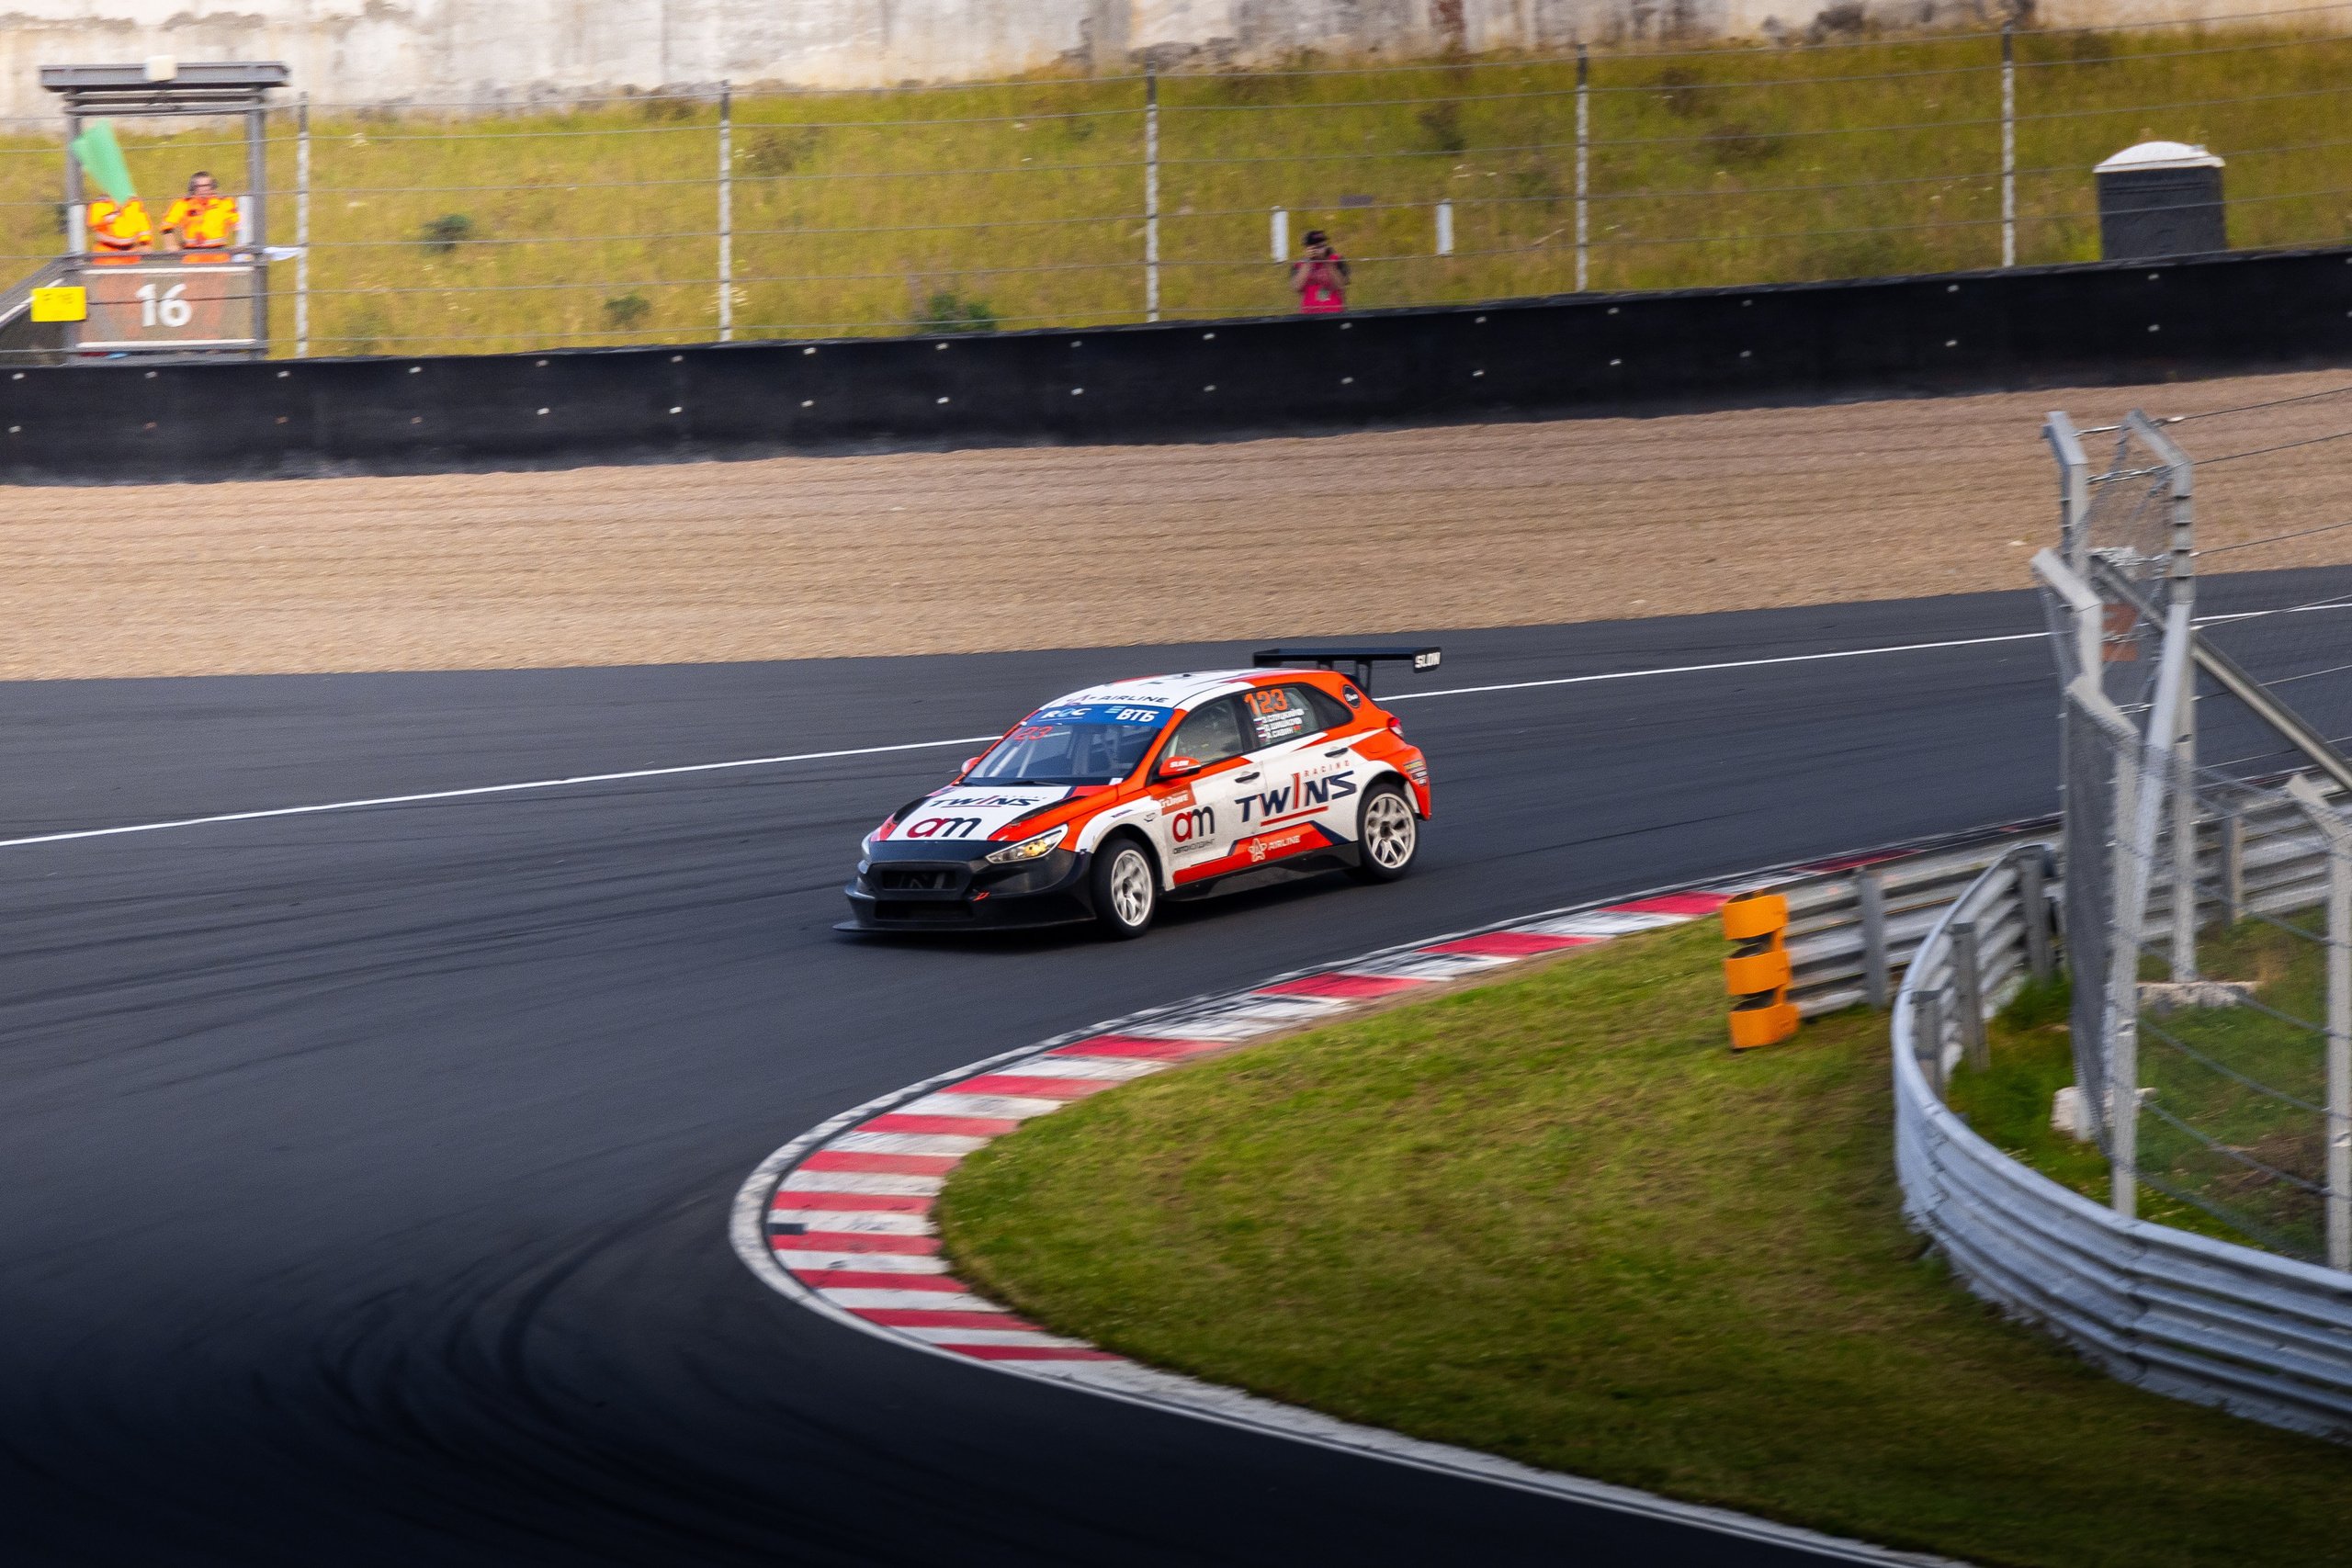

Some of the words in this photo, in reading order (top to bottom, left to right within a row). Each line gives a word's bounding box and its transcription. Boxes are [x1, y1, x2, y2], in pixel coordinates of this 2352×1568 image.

[135, 283, 192, 327] 16
[1098, 695, 1169, 704] AIRLINE
[1244, 688, 1288, 716] 123
[1114, 708, 1160, 723] ВТБ
[929, 795, 1040, 807] TWINS
[1234, 770, 1357, 822] TWINS
[907, 817, 982, 839] am
[1172, 806, 1215, 842] am
[1268, 835, 1301, 851] AIRLINE
